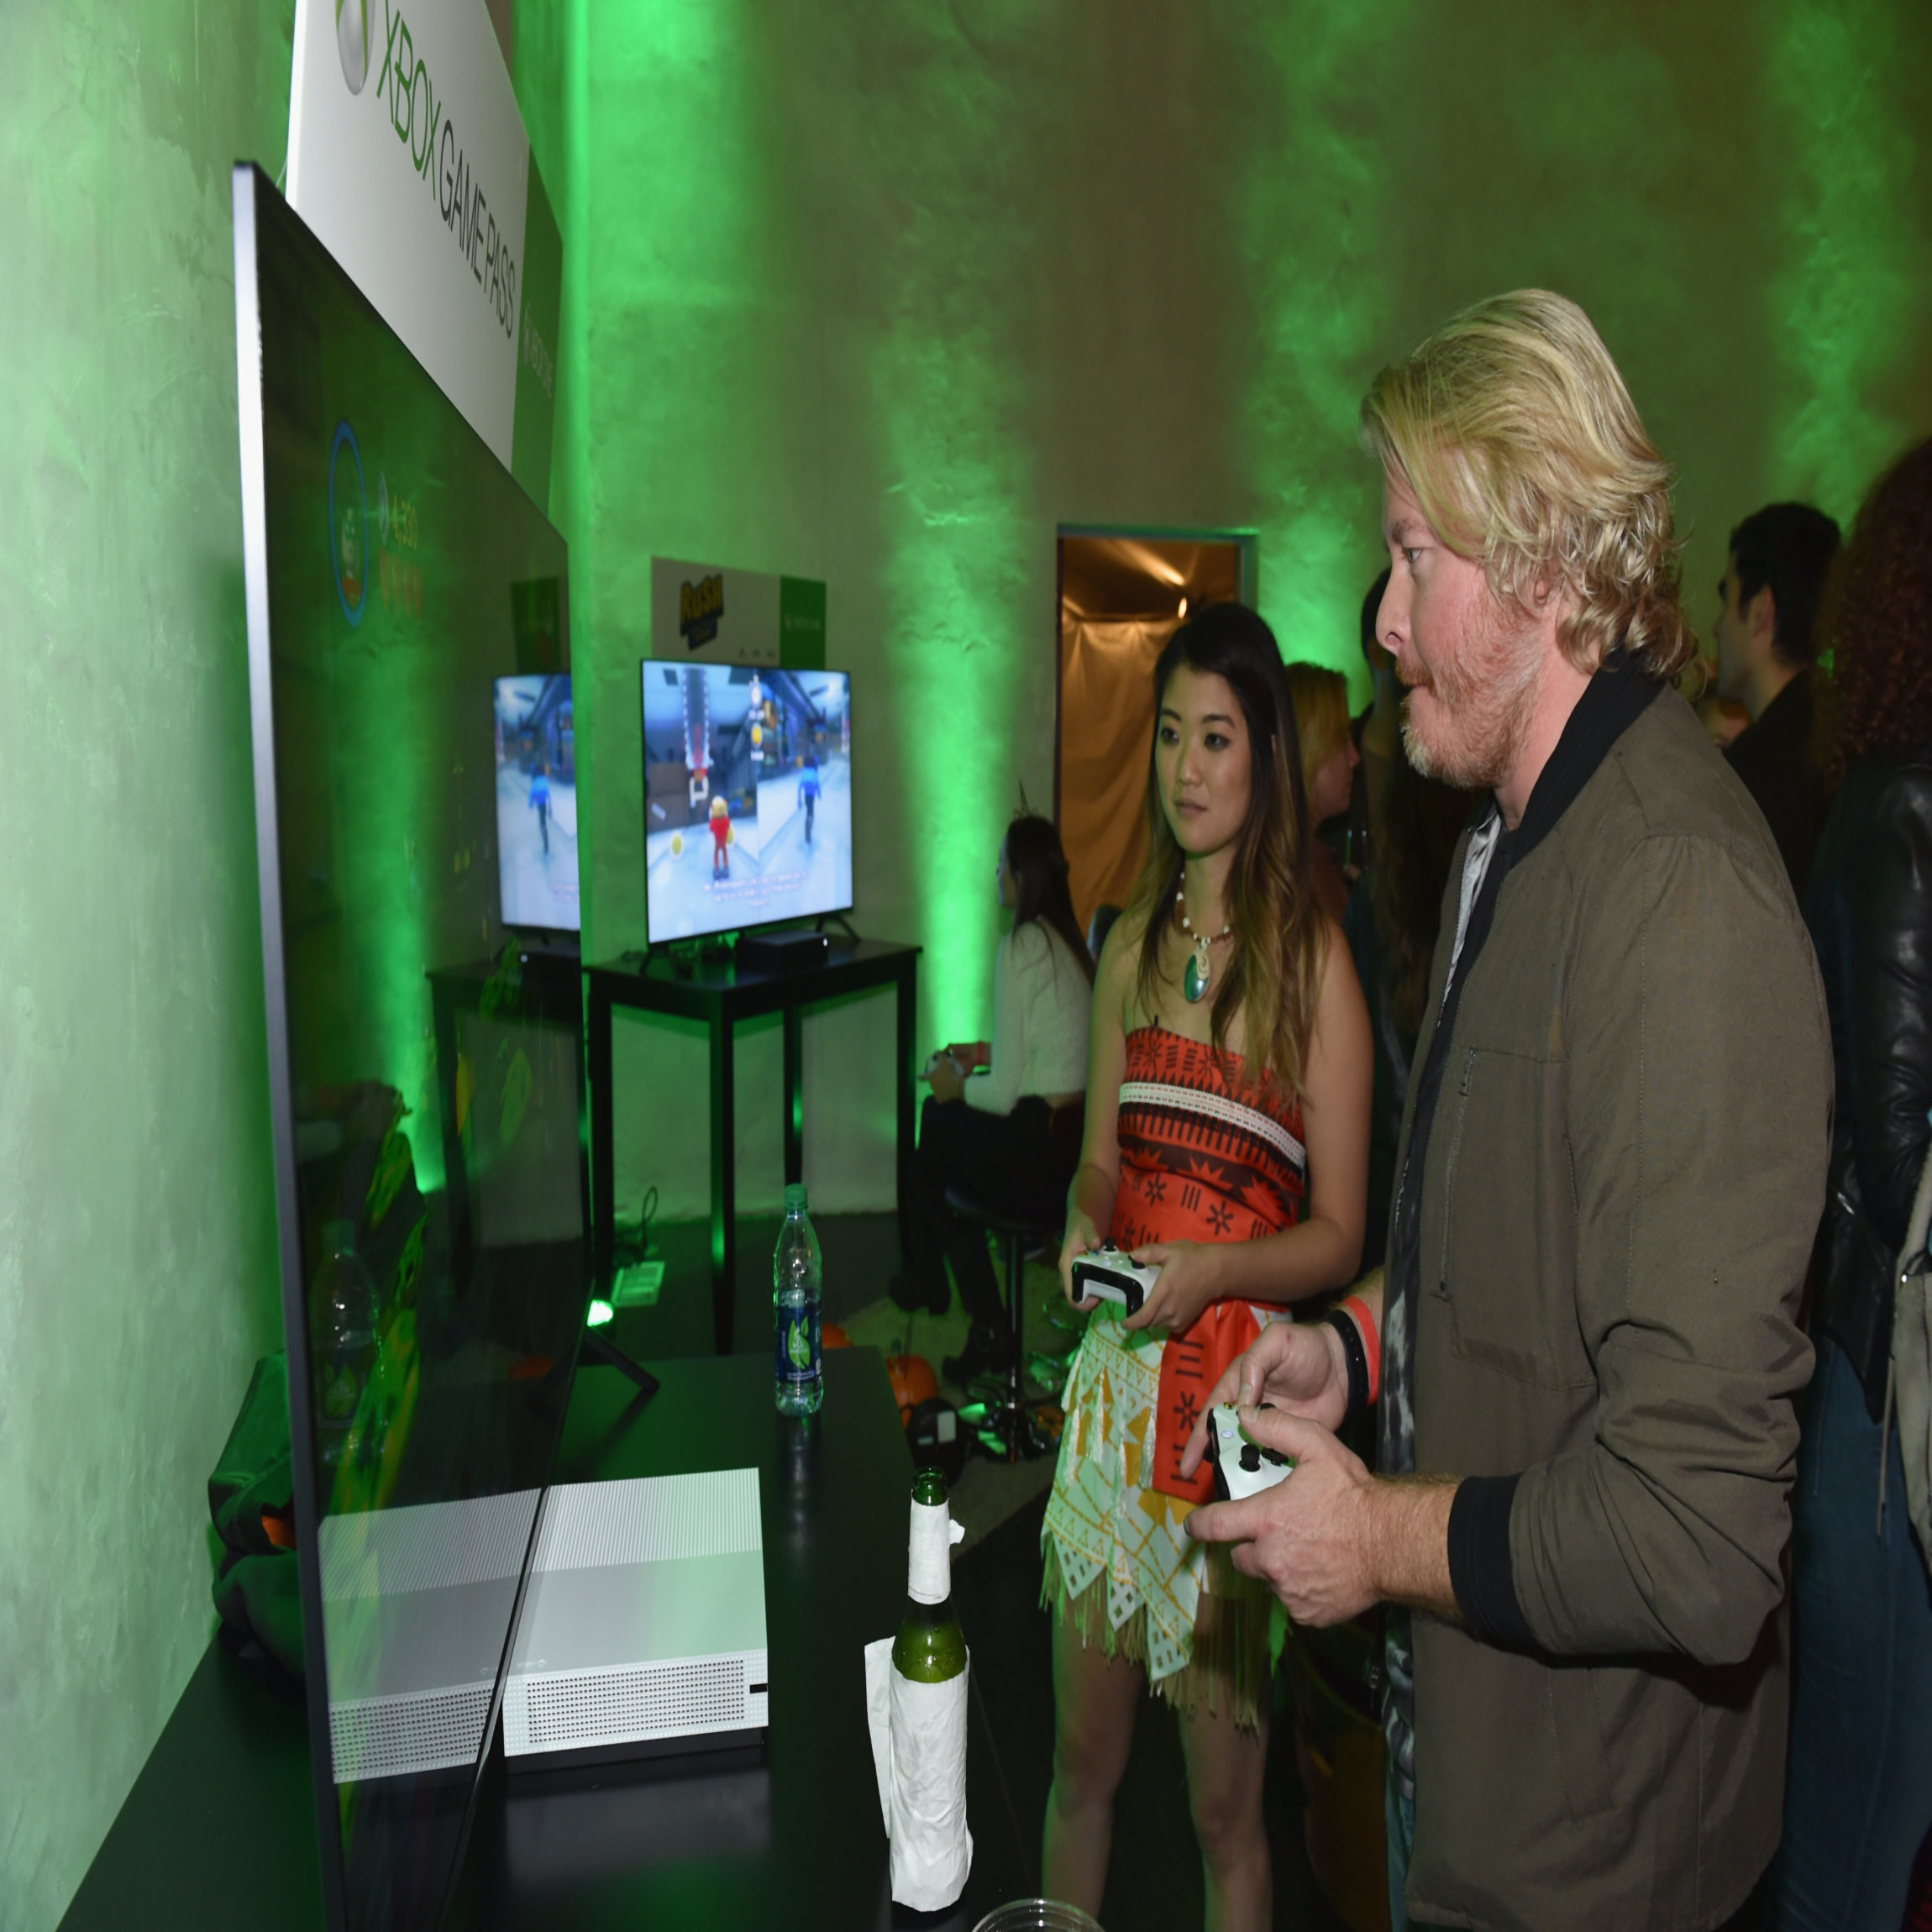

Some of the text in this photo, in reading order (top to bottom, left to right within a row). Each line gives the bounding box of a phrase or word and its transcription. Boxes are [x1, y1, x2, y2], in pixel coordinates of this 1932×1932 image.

[376, 0, 516, 339] XBOX GAME PASS
[680, 575, 723, 625] RUSH
